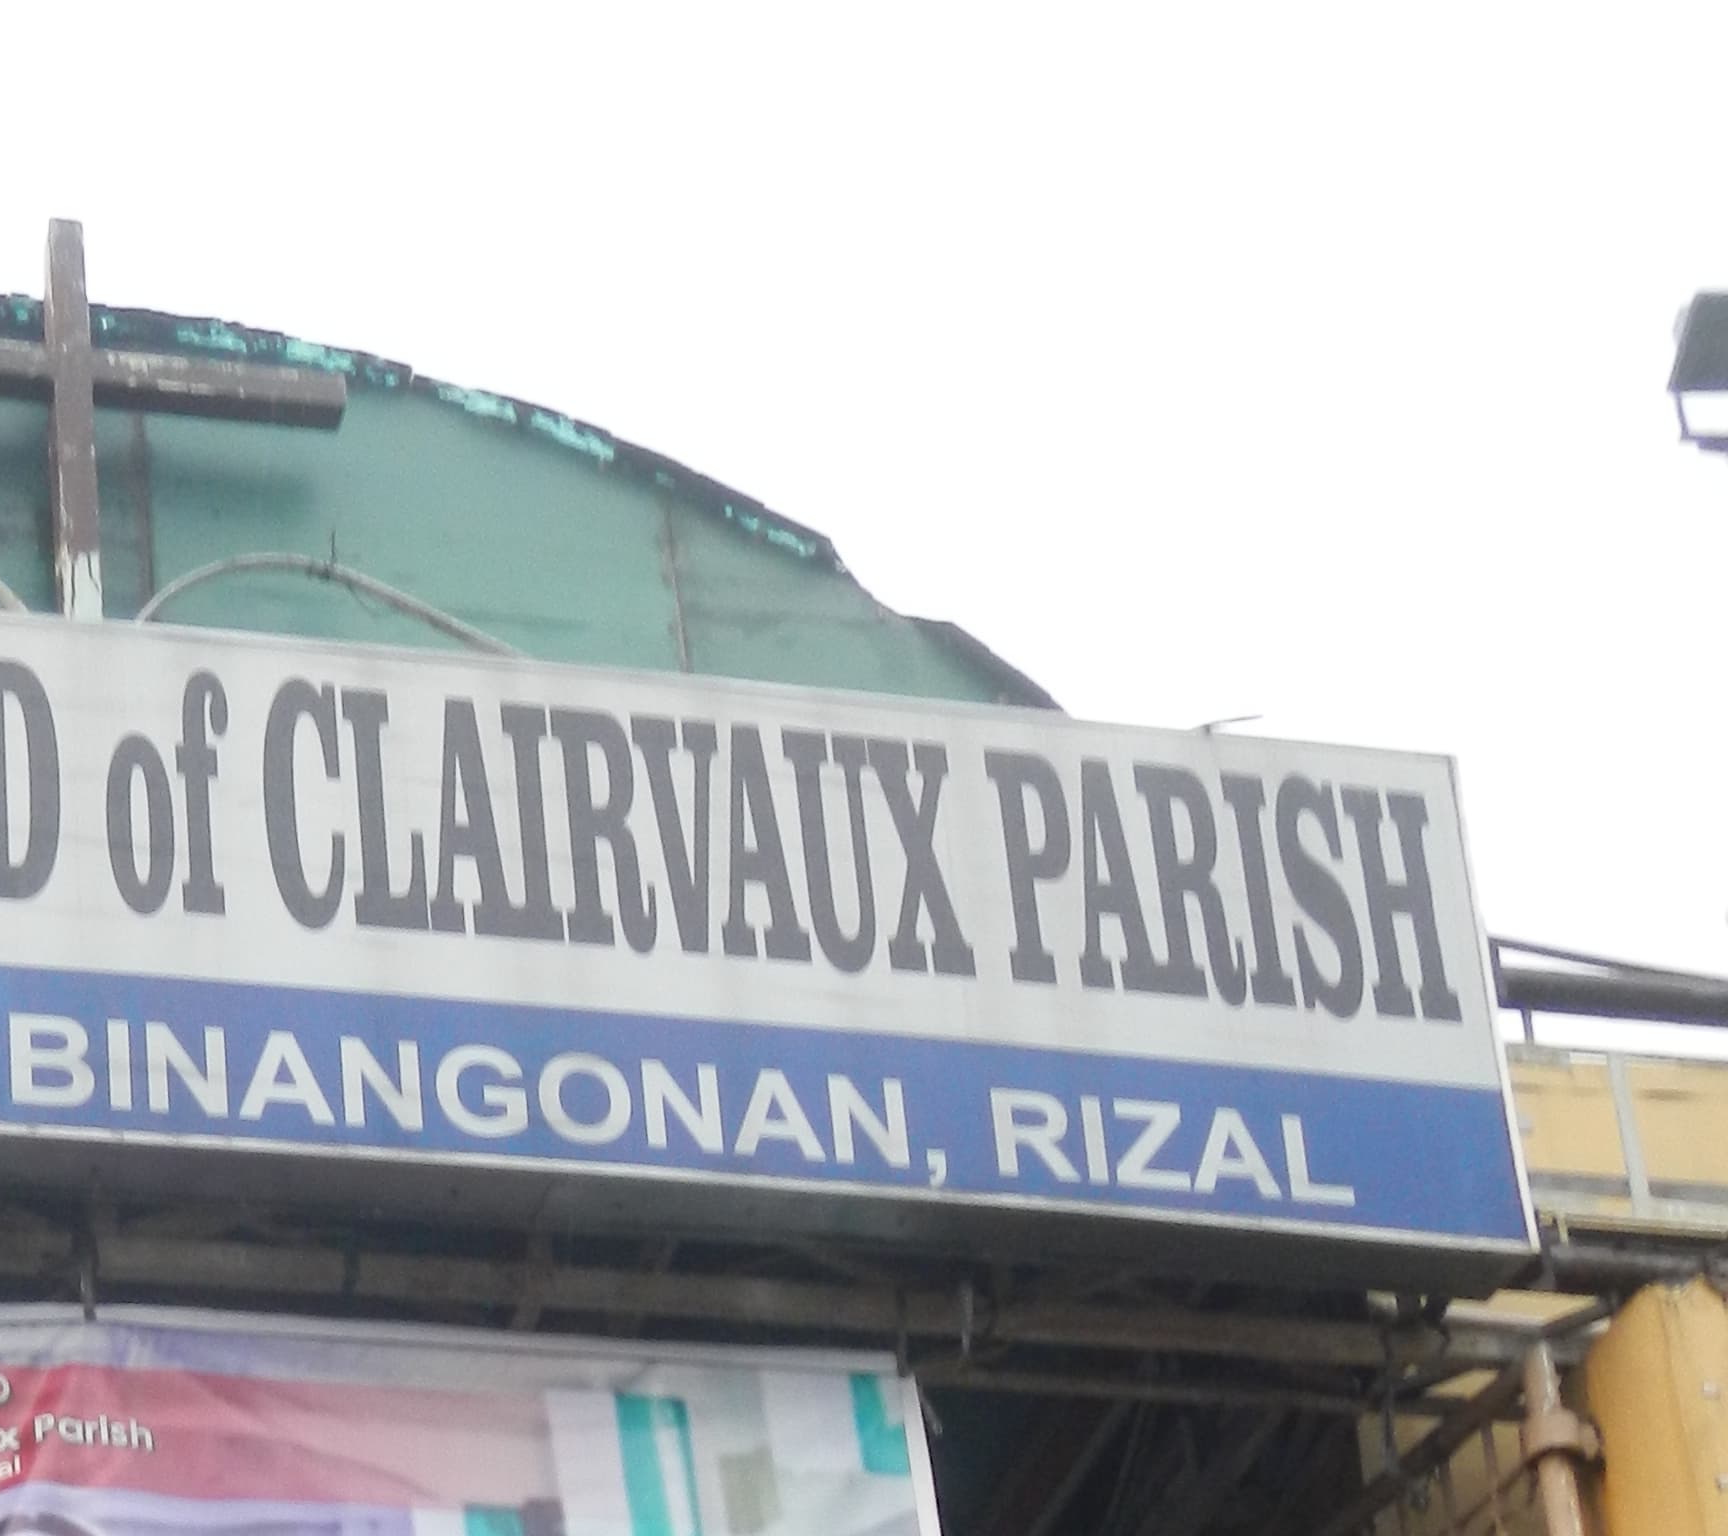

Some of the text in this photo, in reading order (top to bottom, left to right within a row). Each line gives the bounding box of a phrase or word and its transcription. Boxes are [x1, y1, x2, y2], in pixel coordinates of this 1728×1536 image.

[105, 669, 228, 918] of
[263, 676, 974, 977] CLAIRVAUX
[984, 746, 1463, 1024] PARISH
[9, 1013, 949, 1188] BINANGONAN,
[992, 1086, 1355, 1206] RIZAL
[33, 1412, 155, 1452] Parish
